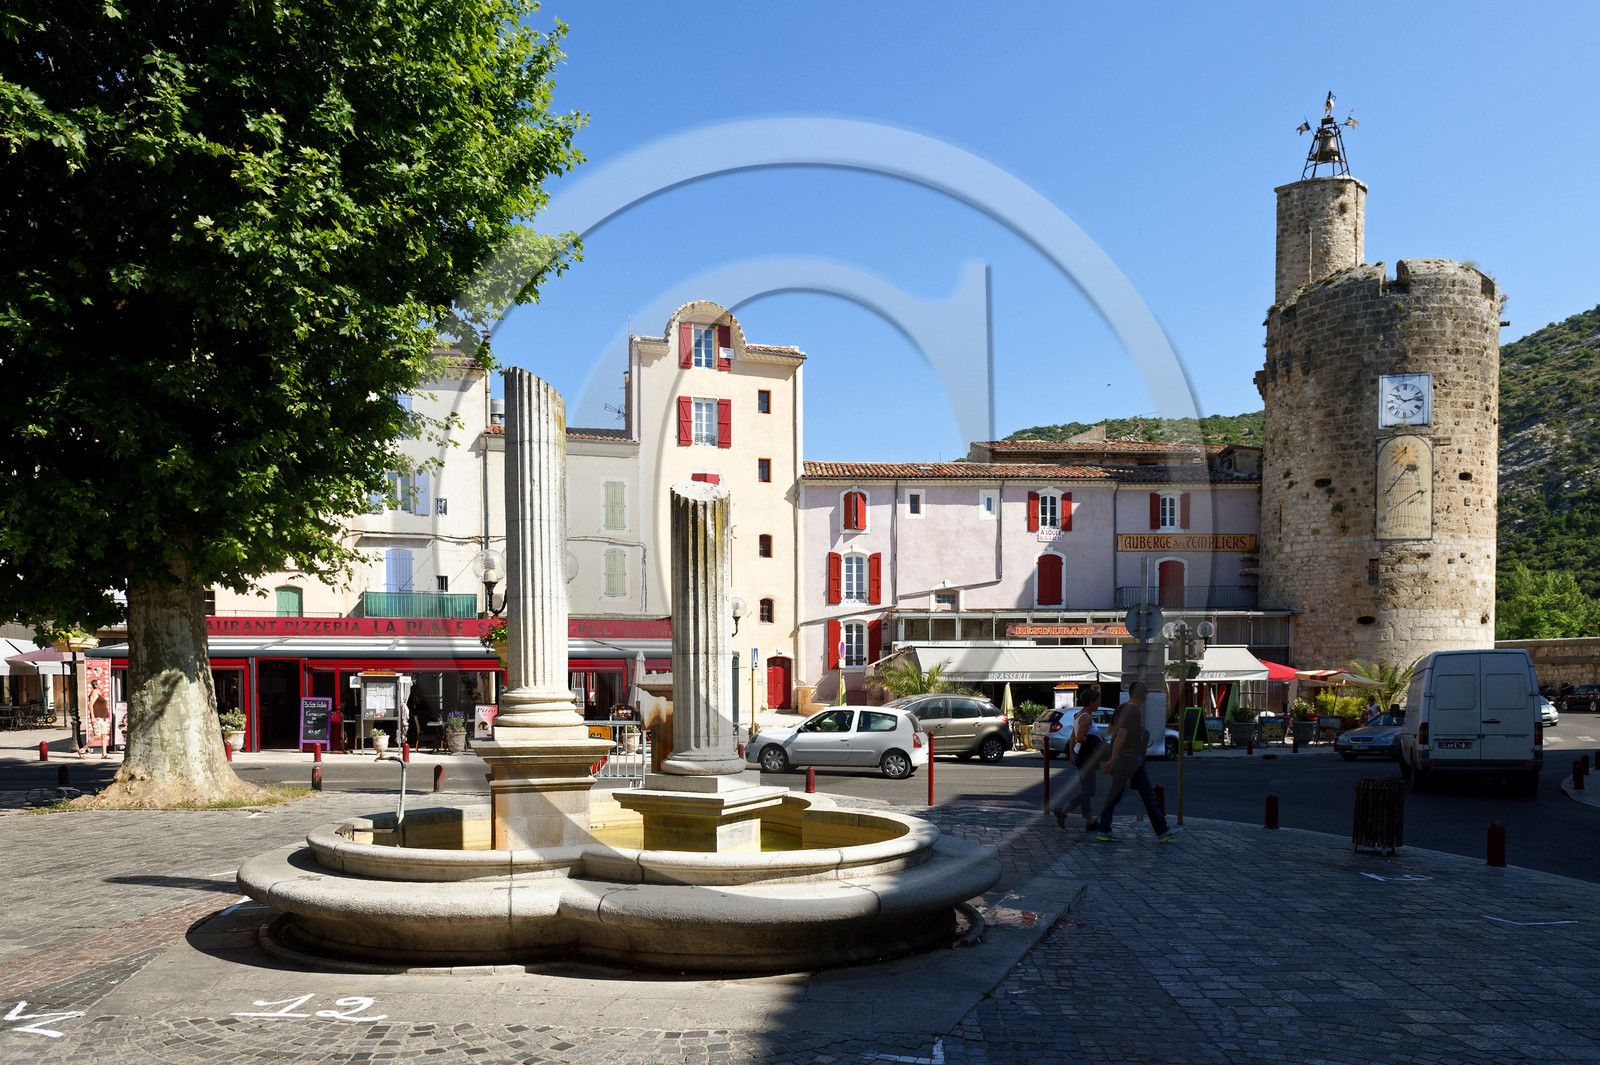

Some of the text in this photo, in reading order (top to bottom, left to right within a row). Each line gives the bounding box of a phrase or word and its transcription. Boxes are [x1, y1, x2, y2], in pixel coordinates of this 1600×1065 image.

[1124, 535, 1247, 549] AUBERGE des TEMPLIERS
[205, 620, 277, 633] AURANT
[284, 621, 361, 633] PIZZERIA
[373, 620, 397, 635] LA
[406, 620, 466, 635] PLACE
[1015, 626, 1095, 635] RESTAURANT
[1107, 626, 1129, 635] GRI
[988, 672, 1031, 681] BRASSERIE
[1195, 672, 1226, 680] LACIER
[228, 993, 388, 1022] 12
